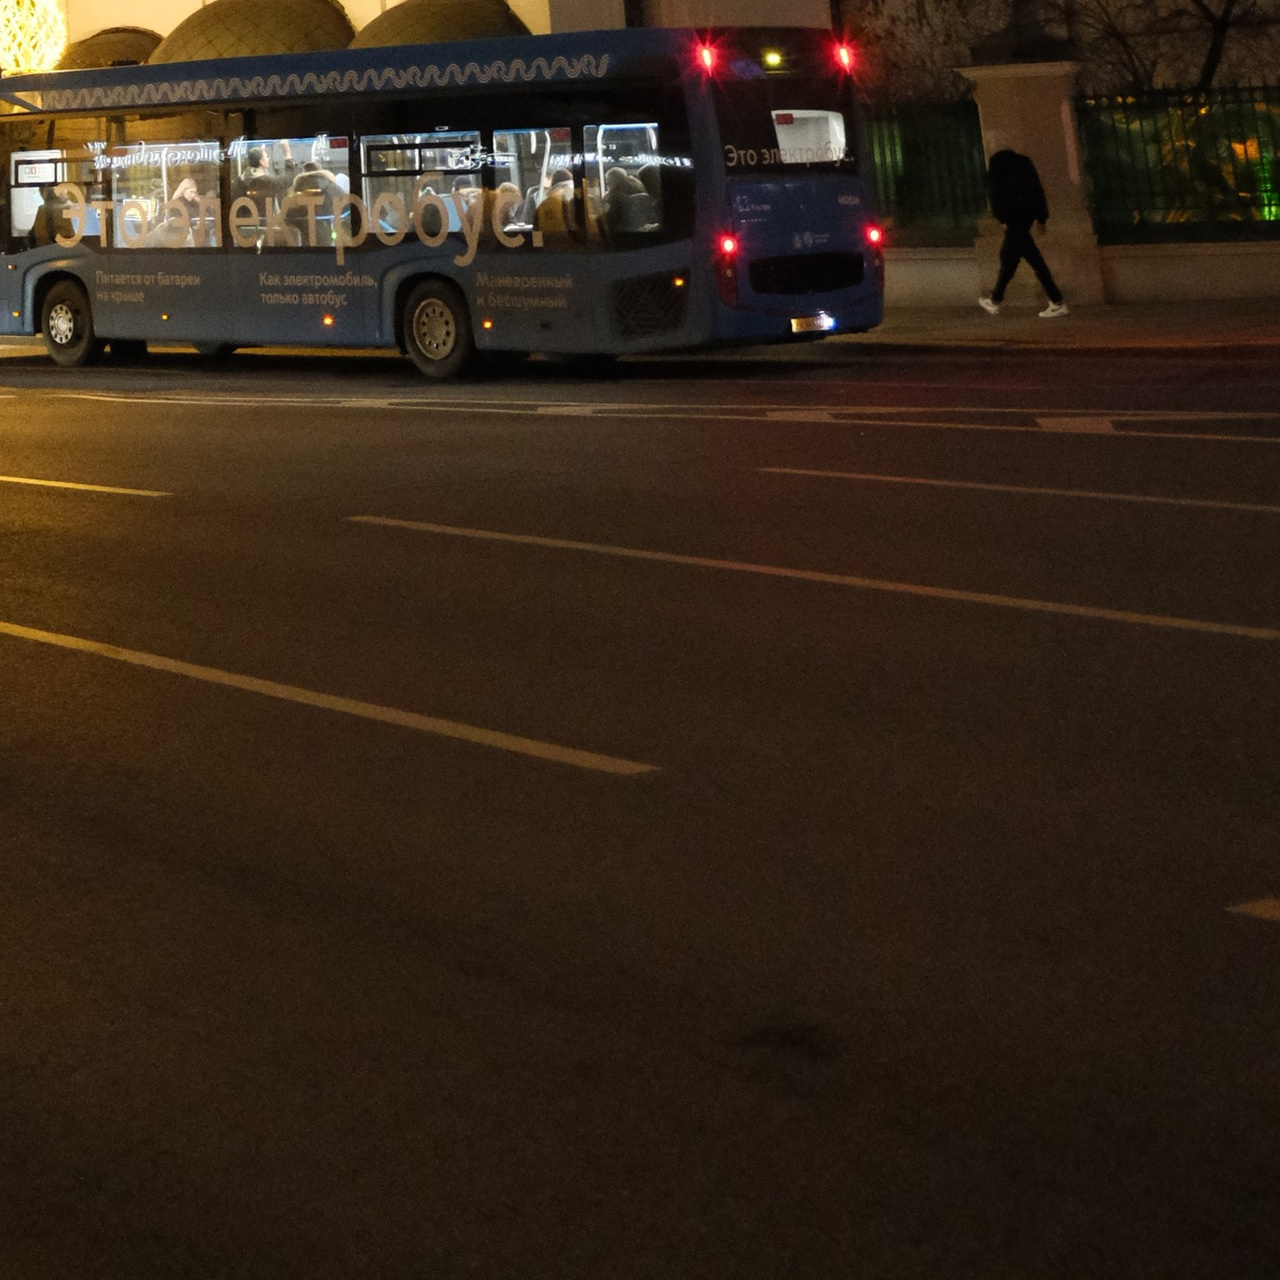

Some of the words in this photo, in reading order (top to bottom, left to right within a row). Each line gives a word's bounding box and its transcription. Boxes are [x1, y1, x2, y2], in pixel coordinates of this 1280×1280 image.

[725, 144, 758, 167] Это
[54, 183, 148, 248] Это
[169, 171, 544, 267] электробус.
[95, 270, 142, 286] Питается
[143, 273, 155, 285] от
[157, 270, 201, 287] батареи
[259, 271, 281, 286] Как
[283, 271, 378, 289] электромобиль,
[96, 291, 109, 301] на
[261, 292, 299, 305] только
[301, 289, 348, 309] автобус
